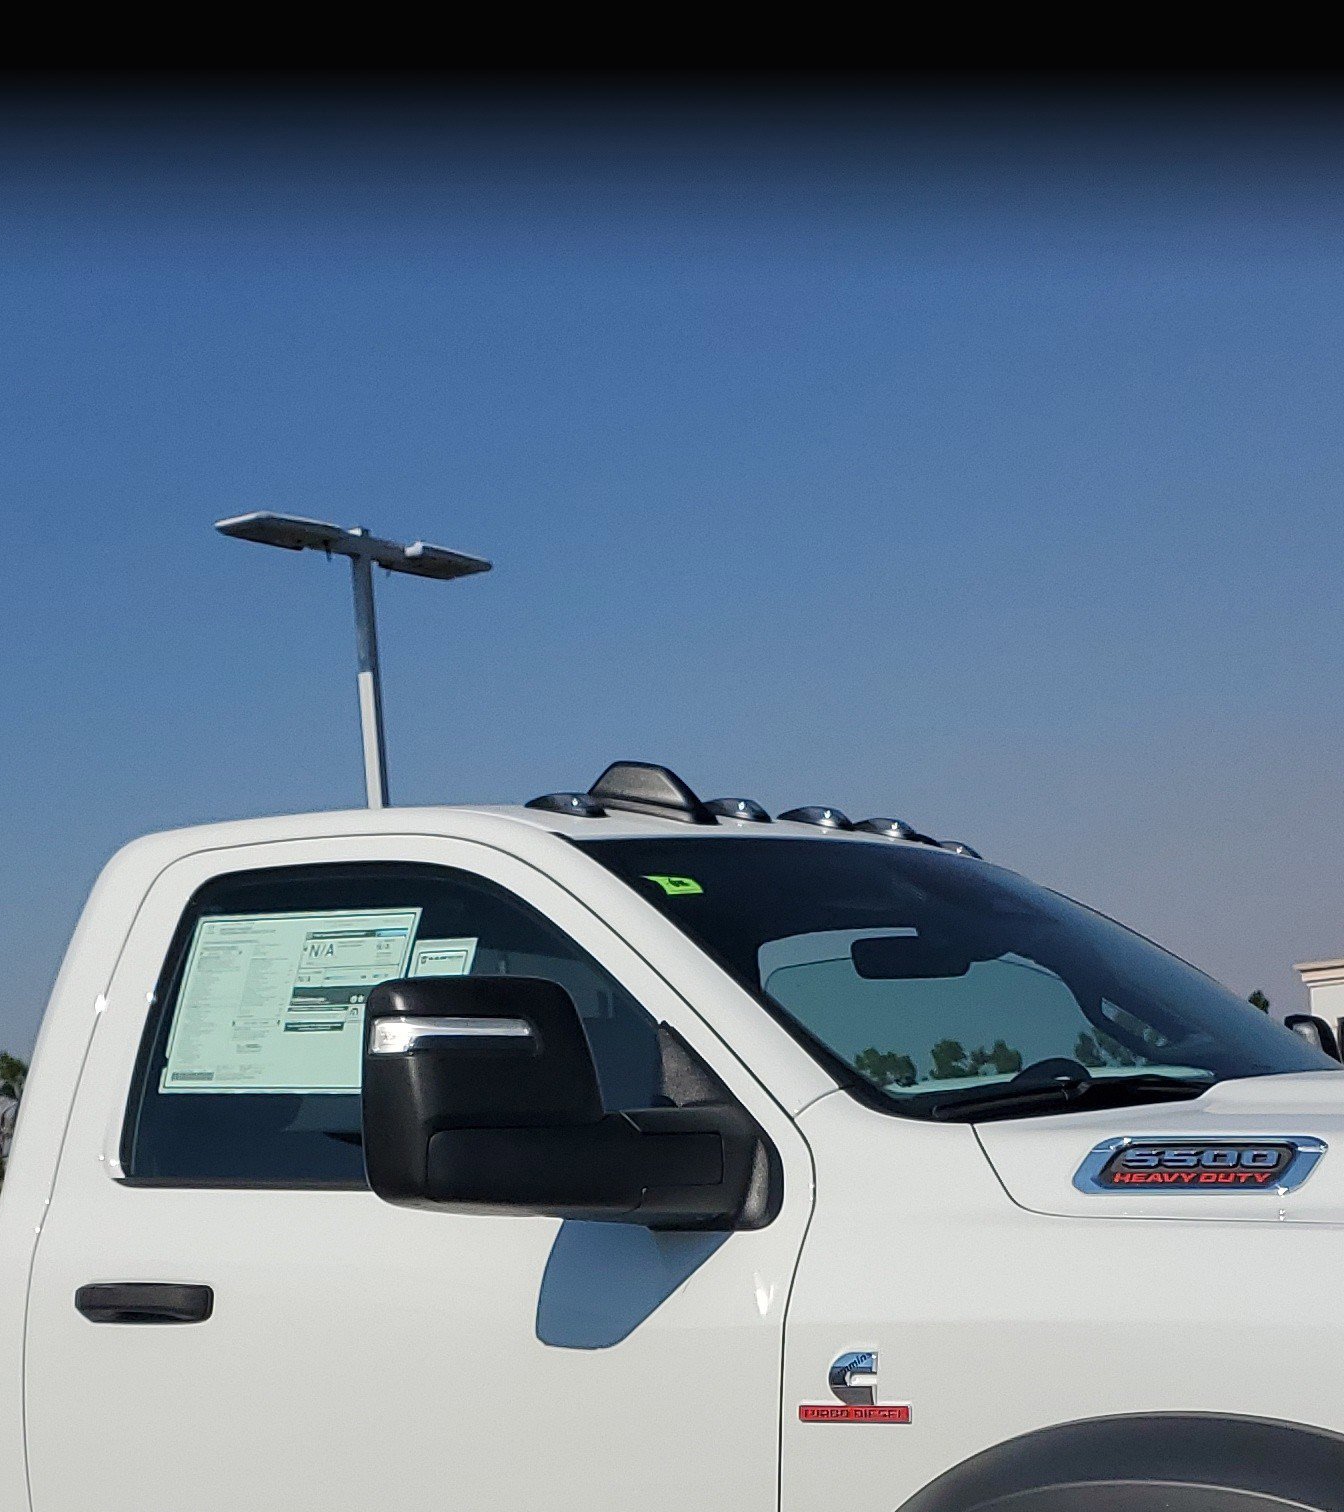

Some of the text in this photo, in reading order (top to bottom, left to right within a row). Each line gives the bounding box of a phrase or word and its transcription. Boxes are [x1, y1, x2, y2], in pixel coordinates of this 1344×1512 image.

[1121, 1147, 1280, 1170] 5500
[1113, 1172, 1272, 1184] HEAVY DUTY
